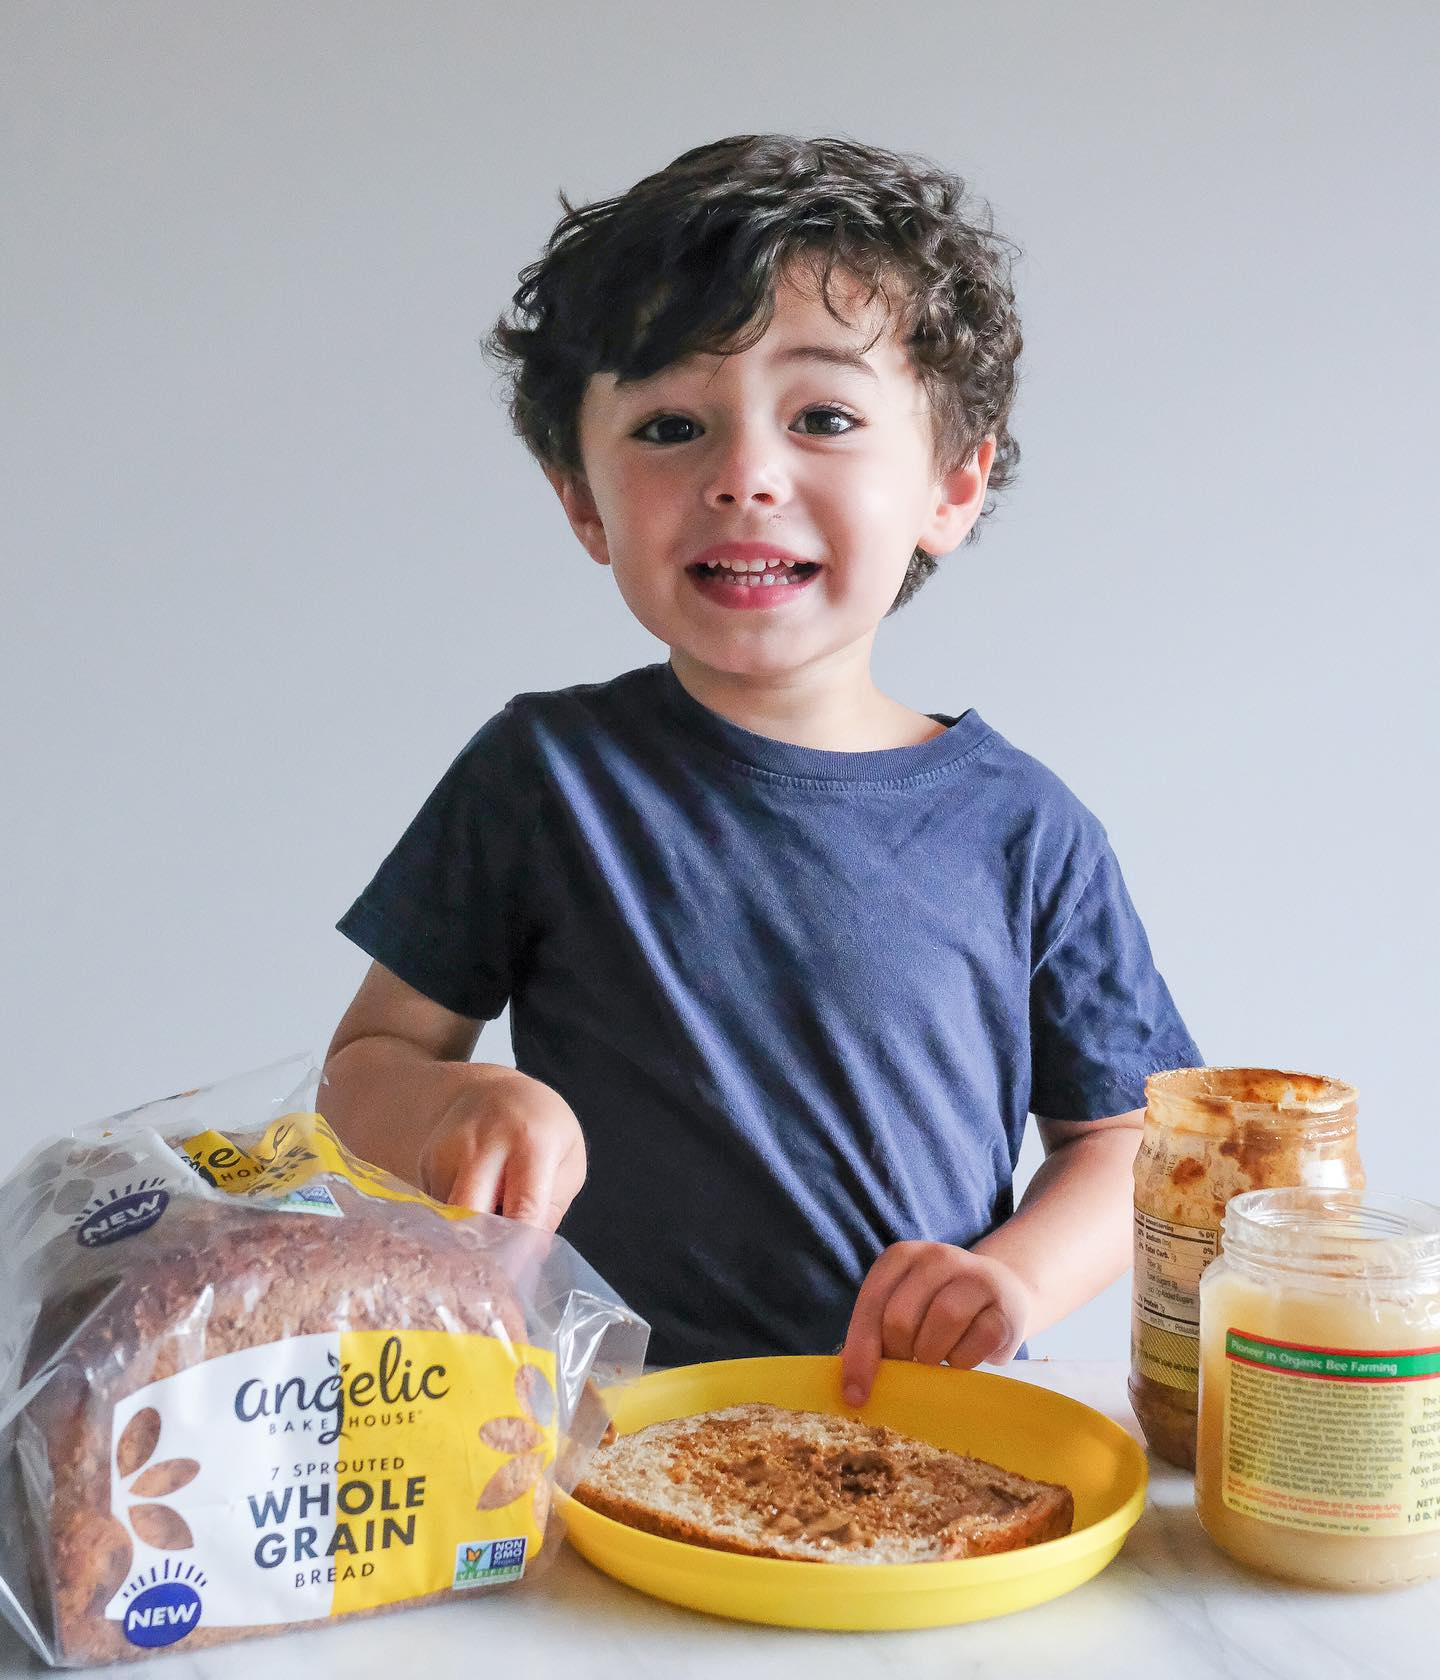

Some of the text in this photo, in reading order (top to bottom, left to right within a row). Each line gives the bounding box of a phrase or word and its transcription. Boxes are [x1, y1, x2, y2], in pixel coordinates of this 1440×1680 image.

[83, 1194, 160, 1240] NEW
[1202, 1247, 1214, 1256] 0%
[1231, 1339, 1398, 1376] Pioneer in Organic Bee Farming
[234, 1336, 450, 1445] angelic
[268, 1411, 417, 1435] BAKE HOUSE
[271, 1457, 405, 1481] 7 SPROUTED
[1420, 1476, 1440, 1489] Syste
[247, 1476, 426, 1529] WHOLE
[1416, 1497, 1433, 1509] NET
[254, 1514, 416, 1569] GRAIN
[494, 1548, 522, 1560] GMO
[495, 1540, 523, 1552] NON
[295, 1562, 375, 1588] BREAD
[128, 1601, 199, 1632] NEW
